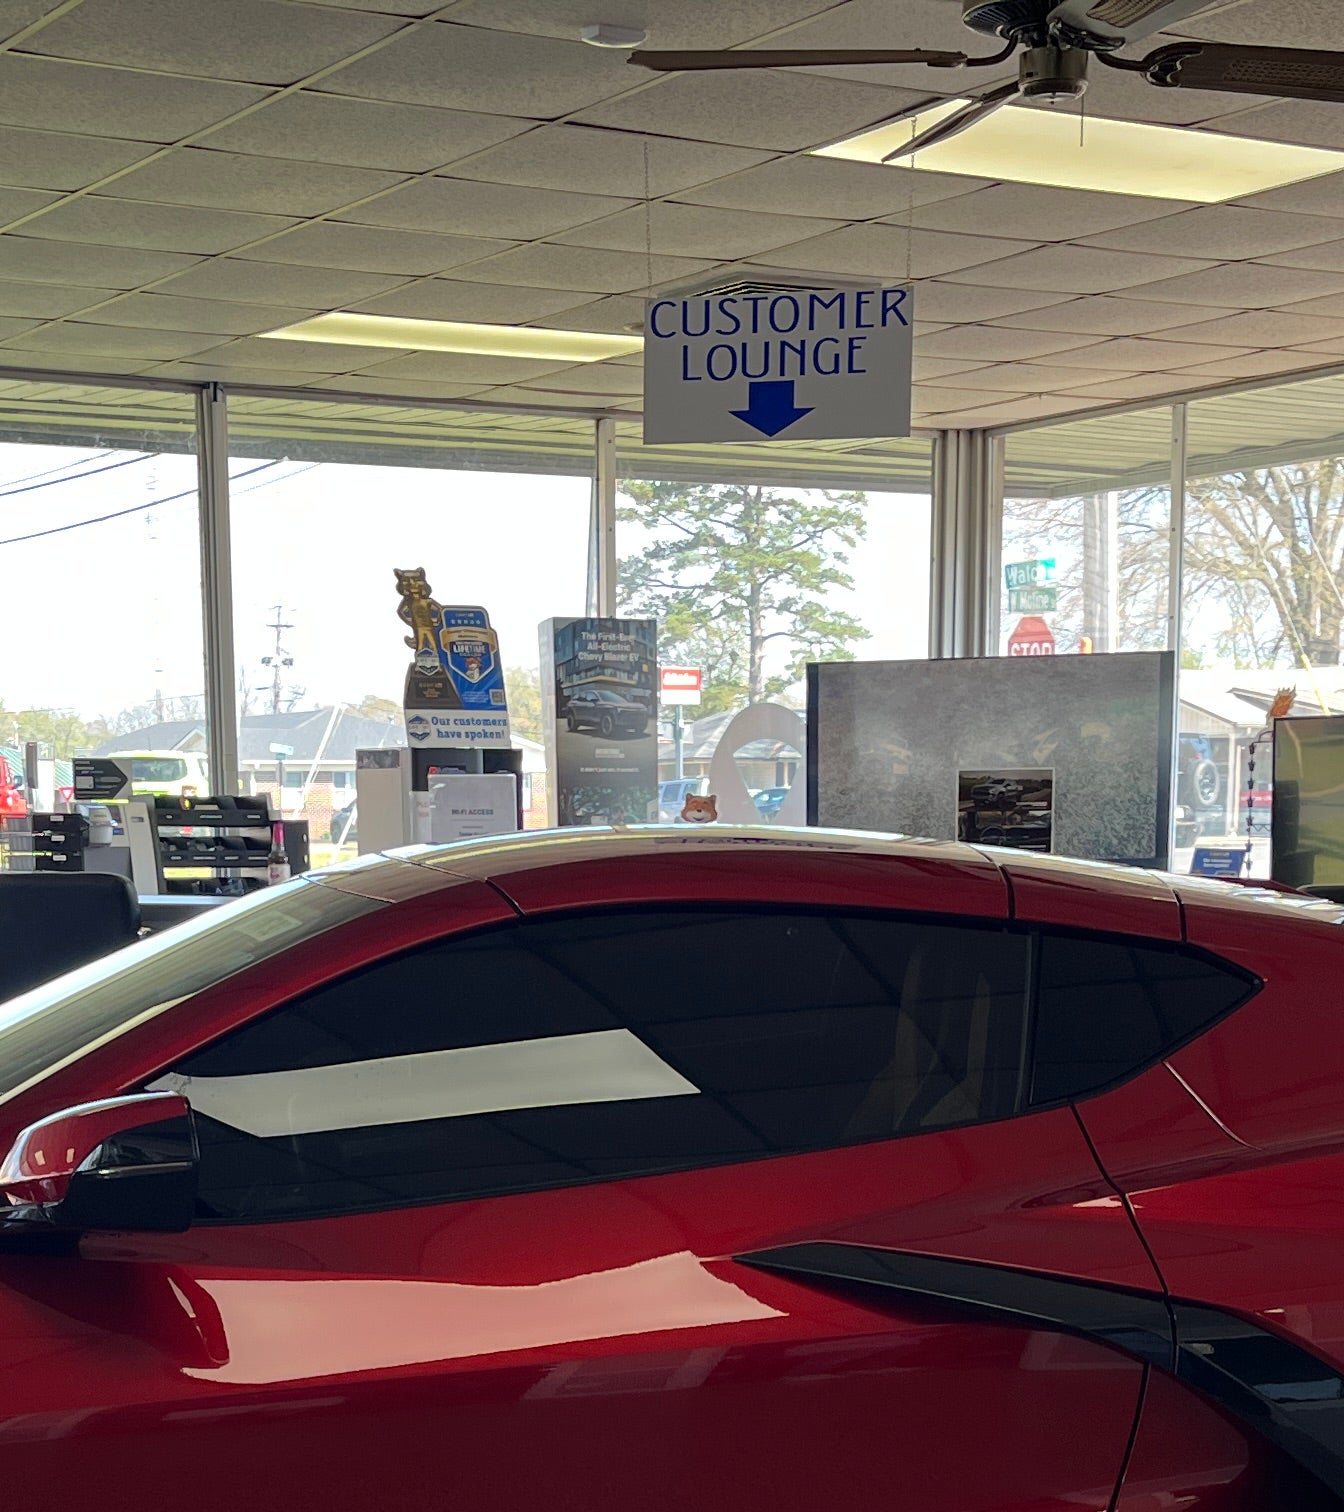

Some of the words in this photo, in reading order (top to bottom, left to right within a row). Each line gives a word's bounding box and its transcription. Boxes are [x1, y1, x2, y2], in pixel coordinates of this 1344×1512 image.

[650, 289, 909, 339] CUSTOMER
[682, 336, 868, 382] LOUNGE
[1011, 641, 1053, 656] STOP
[431, 716, 451, 726] Our
[453, 717, 507, 727] customers
[437, 728, 462, 738] have
